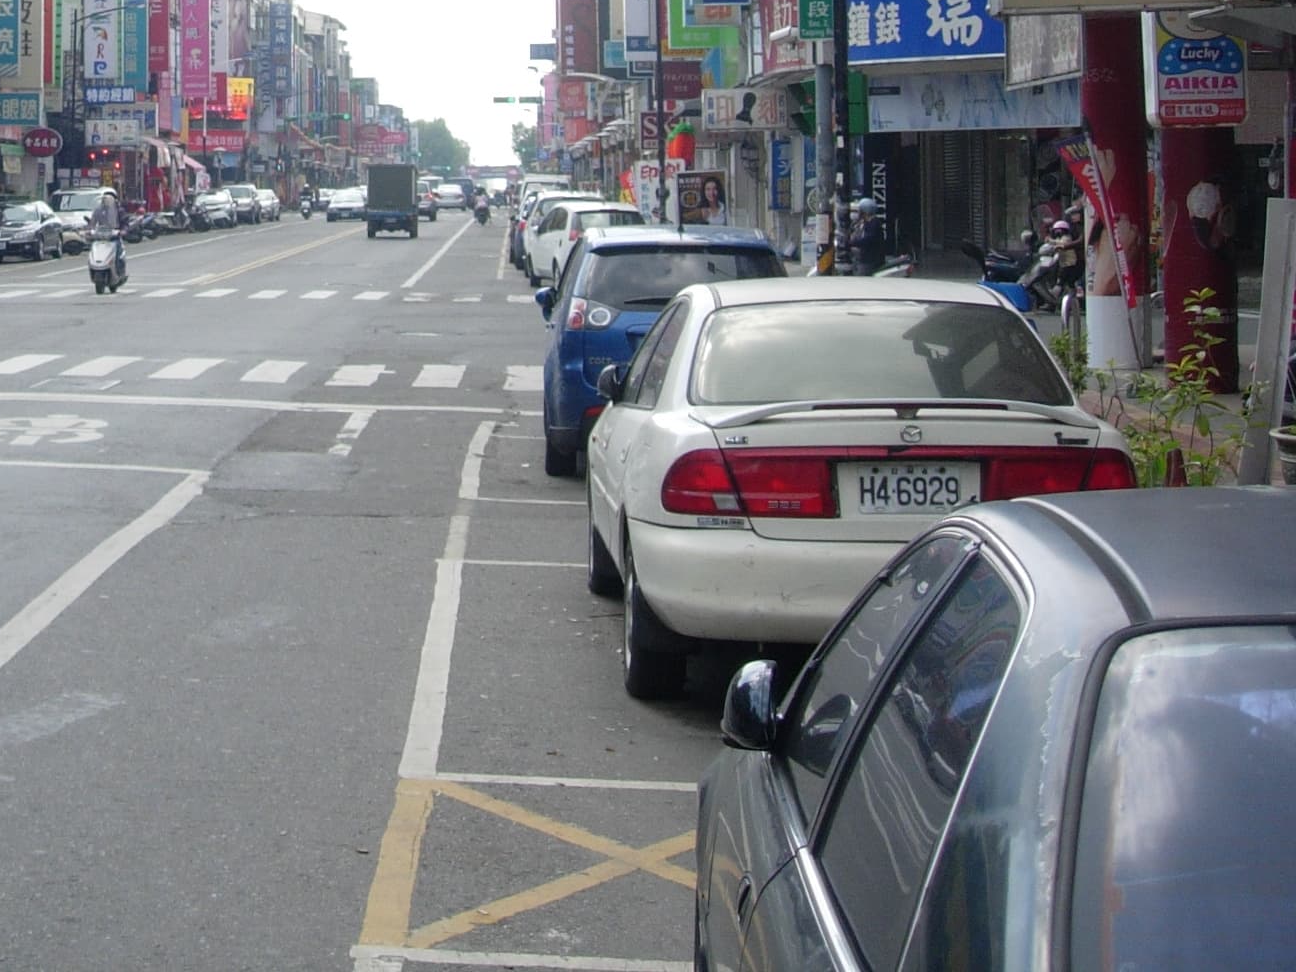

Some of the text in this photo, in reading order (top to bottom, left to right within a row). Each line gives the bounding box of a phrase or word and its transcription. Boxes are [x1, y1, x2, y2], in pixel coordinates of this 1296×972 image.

[847, 0, 901, 48] 鐘錶
[1180, 46, 1221, 62] Lucky
[1164, 75, 1238, 90] AIKIA
